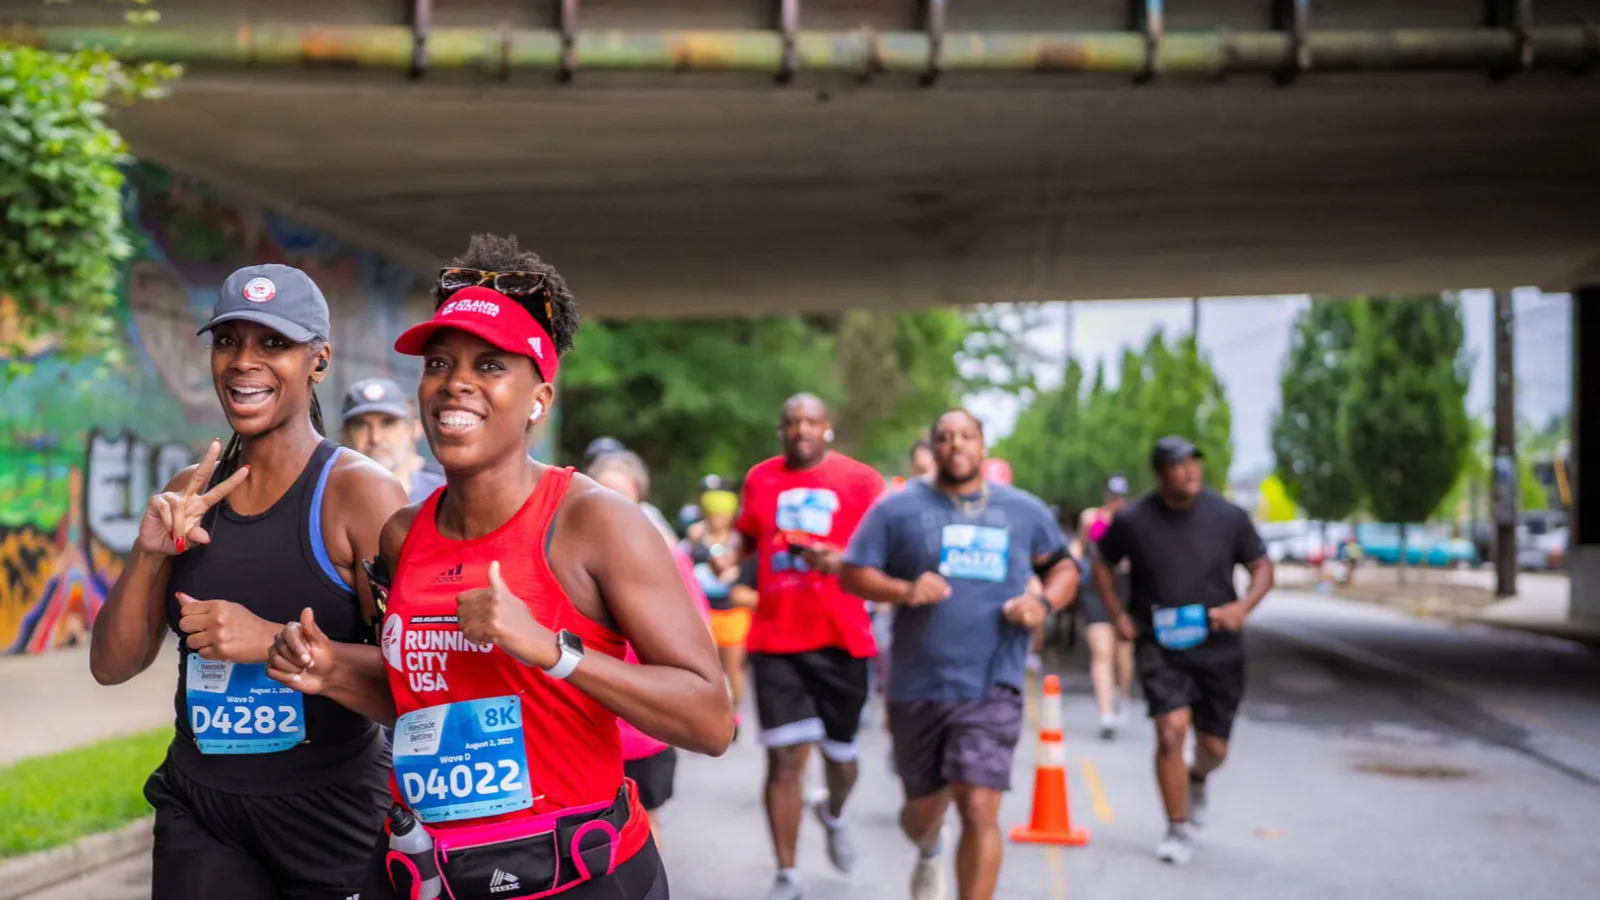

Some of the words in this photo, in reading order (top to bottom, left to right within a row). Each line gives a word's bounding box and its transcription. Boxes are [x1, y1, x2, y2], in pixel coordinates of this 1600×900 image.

[455, 299, 500, 314] ATLANTA
[406, 652, 448, 671] CITY
[408, 672, 448, 692] USA
[249, 687, 271, 695] August
[192, 705, 299, 734] D4282
[485, 706, 516, 727] 8K
[407, 720, 436, 732] Westside
[464, 741, 489, 751] August
[489, 739, 497, 747] 2,
[497, 737, 514, 745] 2025
[440, 755, 464, 764] Wave
[464, 753, 471, 761] D
[402, 759, 523, 804] D4022
